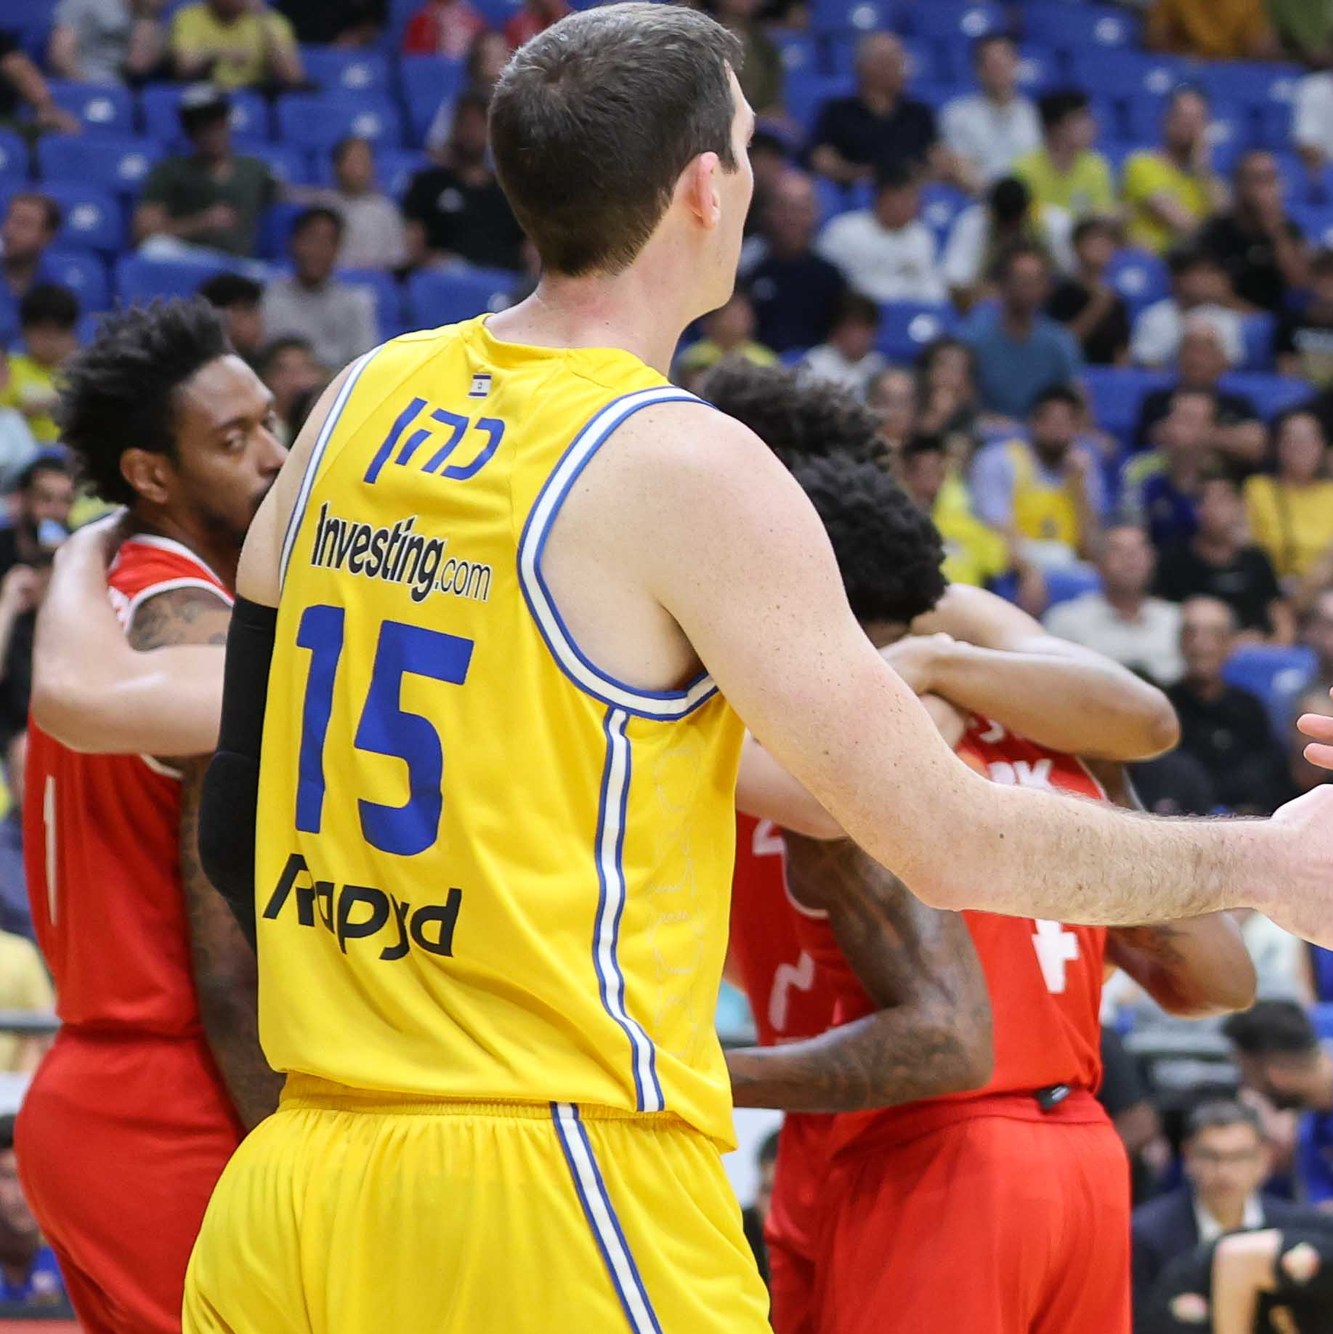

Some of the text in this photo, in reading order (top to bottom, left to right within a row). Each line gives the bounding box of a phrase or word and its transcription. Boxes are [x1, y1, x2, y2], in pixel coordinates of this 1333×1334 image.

[364, 398, 505, 484] כהן
[311, 501, 491, 602] Investing.com
[296, 604, 474, 856] 15
